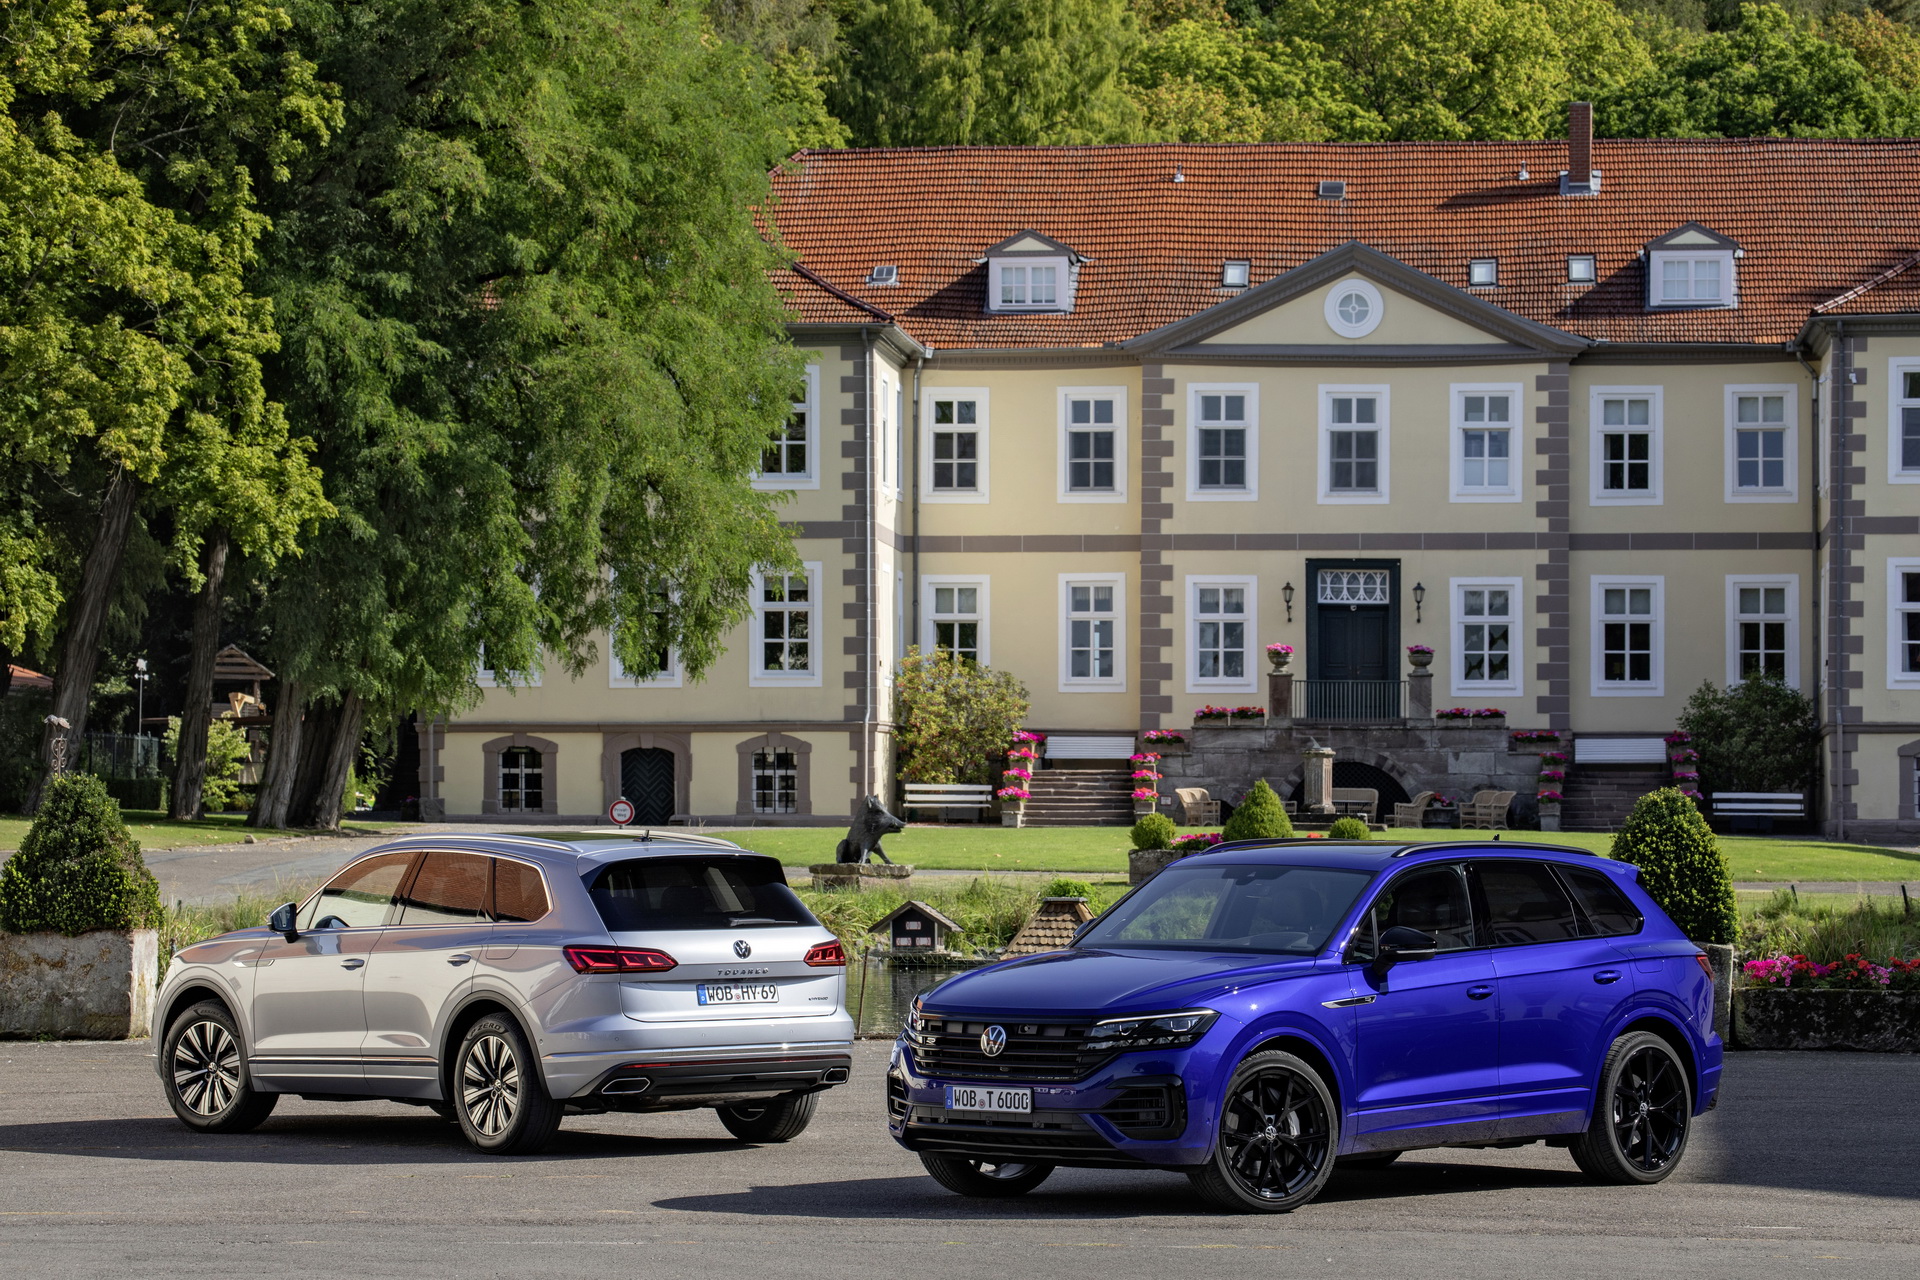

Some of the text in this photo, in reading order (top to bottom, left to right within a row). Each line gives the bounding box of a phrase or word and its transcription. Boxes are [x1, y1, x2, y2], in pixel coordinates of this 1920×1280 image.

[706, 985, 733, 1001] WOB
[954, 1089, 977, 1108] WOB
[986, 1090, 994, 1108] T
[997, 1091, 1029, 1110] 6000
